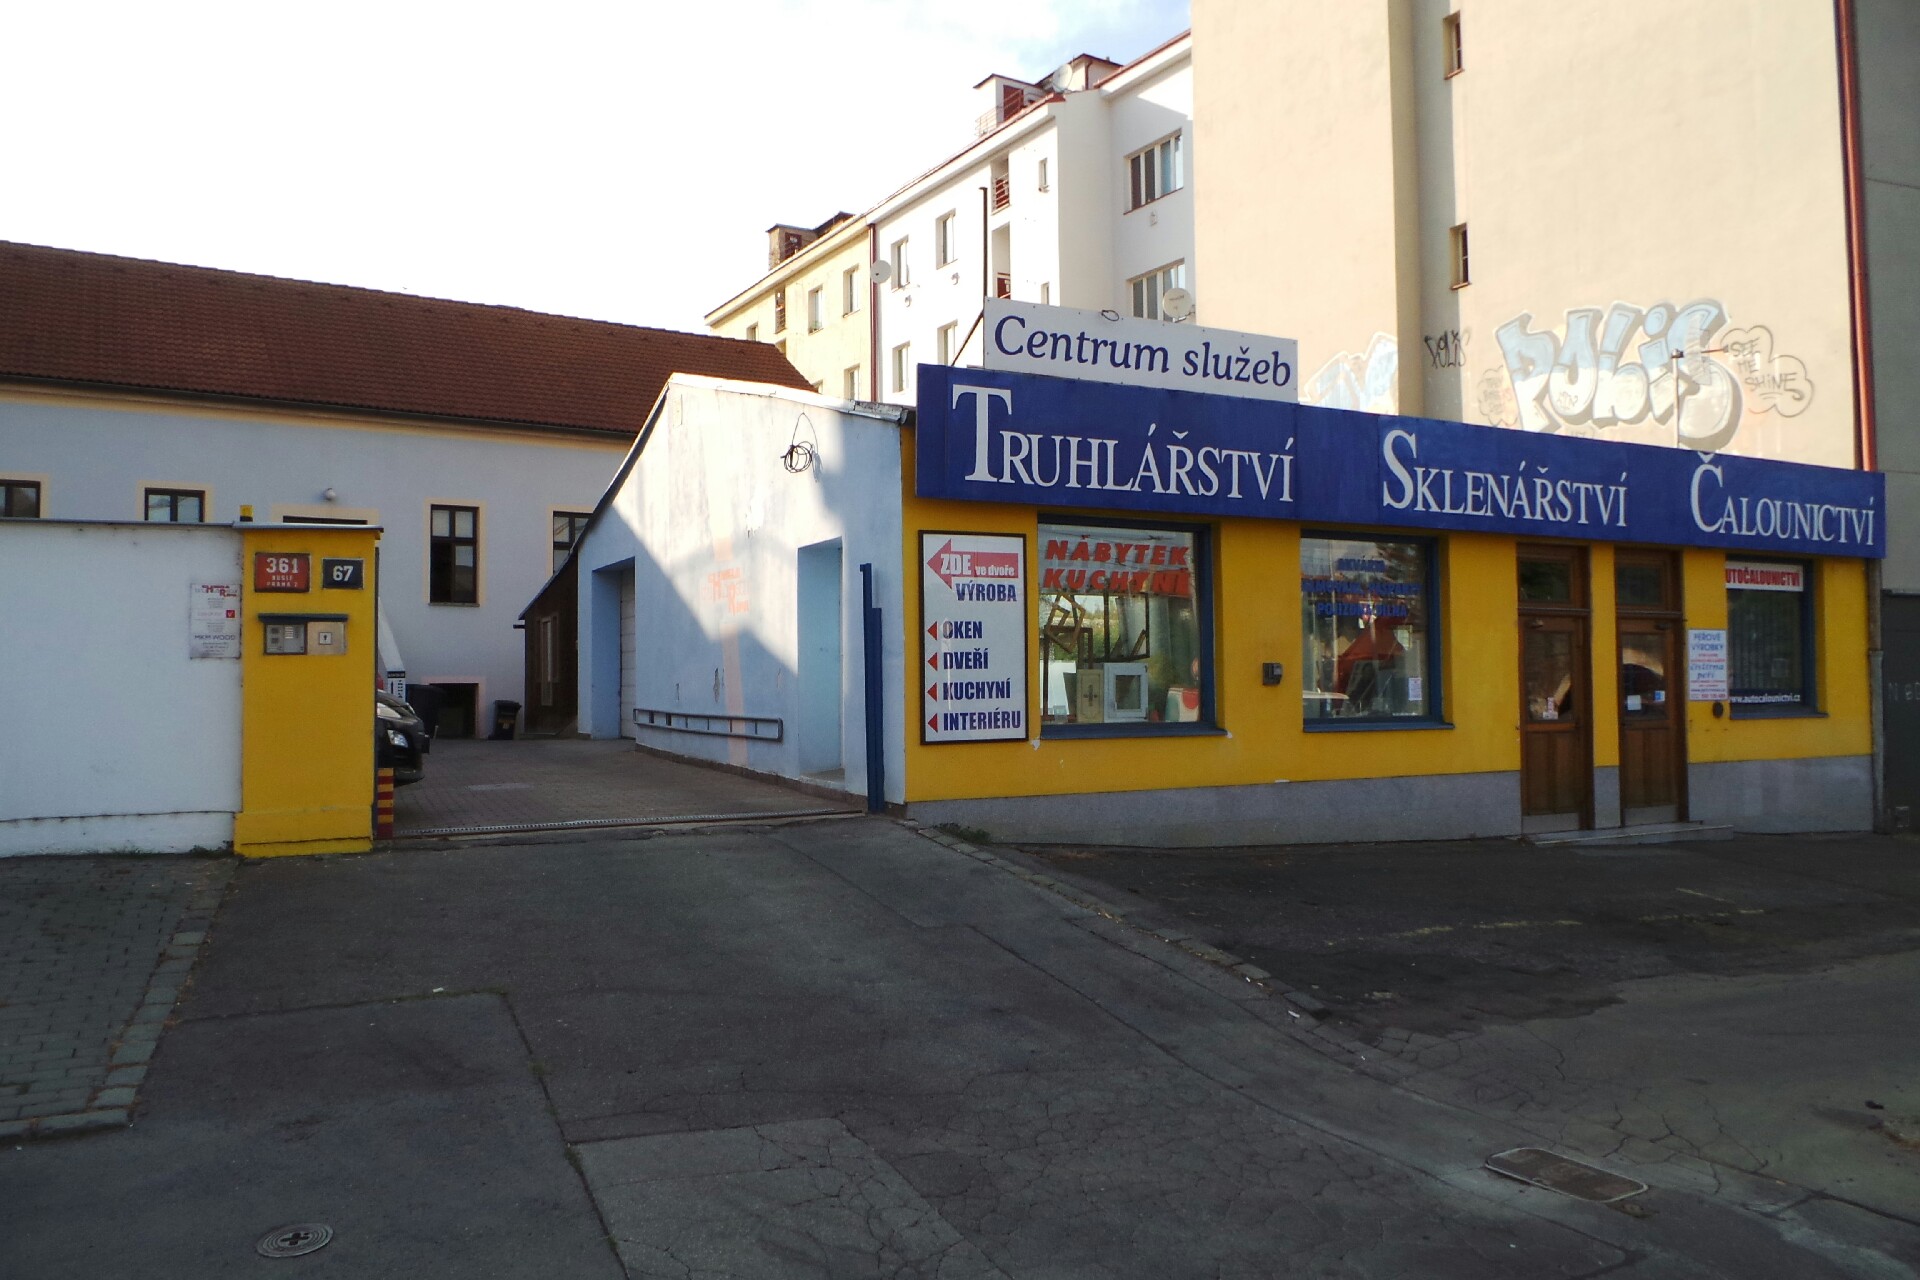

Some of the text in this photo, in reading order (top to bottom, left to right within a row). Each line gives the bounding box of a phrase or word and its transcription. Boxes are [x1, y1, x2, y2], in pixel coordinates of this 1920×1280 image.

[995, 315, 1169, 373] Centrum
[1182, 341, 1291, 387] služeb
[952, 384, 1294, 503] TRUHLÁŘSTVÍ
[1383, 429, 1628, 527] SKLENÁŘSTVÍ
[1691, 451, 1876, 546] ČALOUNICTVÍ
[1045, 534, 1189, 566] NÁBYTEK
[266, 558, 299, 574] 361
[332, 565, 354, 581] 67
[941, 553, 1015, 576] ZDE ve dvoře
[955, 580, 1017, 602] VÝROBA
[1043, 567, 1191, 597] KUCHYNÍ
[943, 621, 982, 639] OKEN
[943, 648, 988, 669] DVEŘÍ
[943, 678, 1010, 700] KUCHYNÍ
[943, 707, 1021, 731] INTERIÉRU
